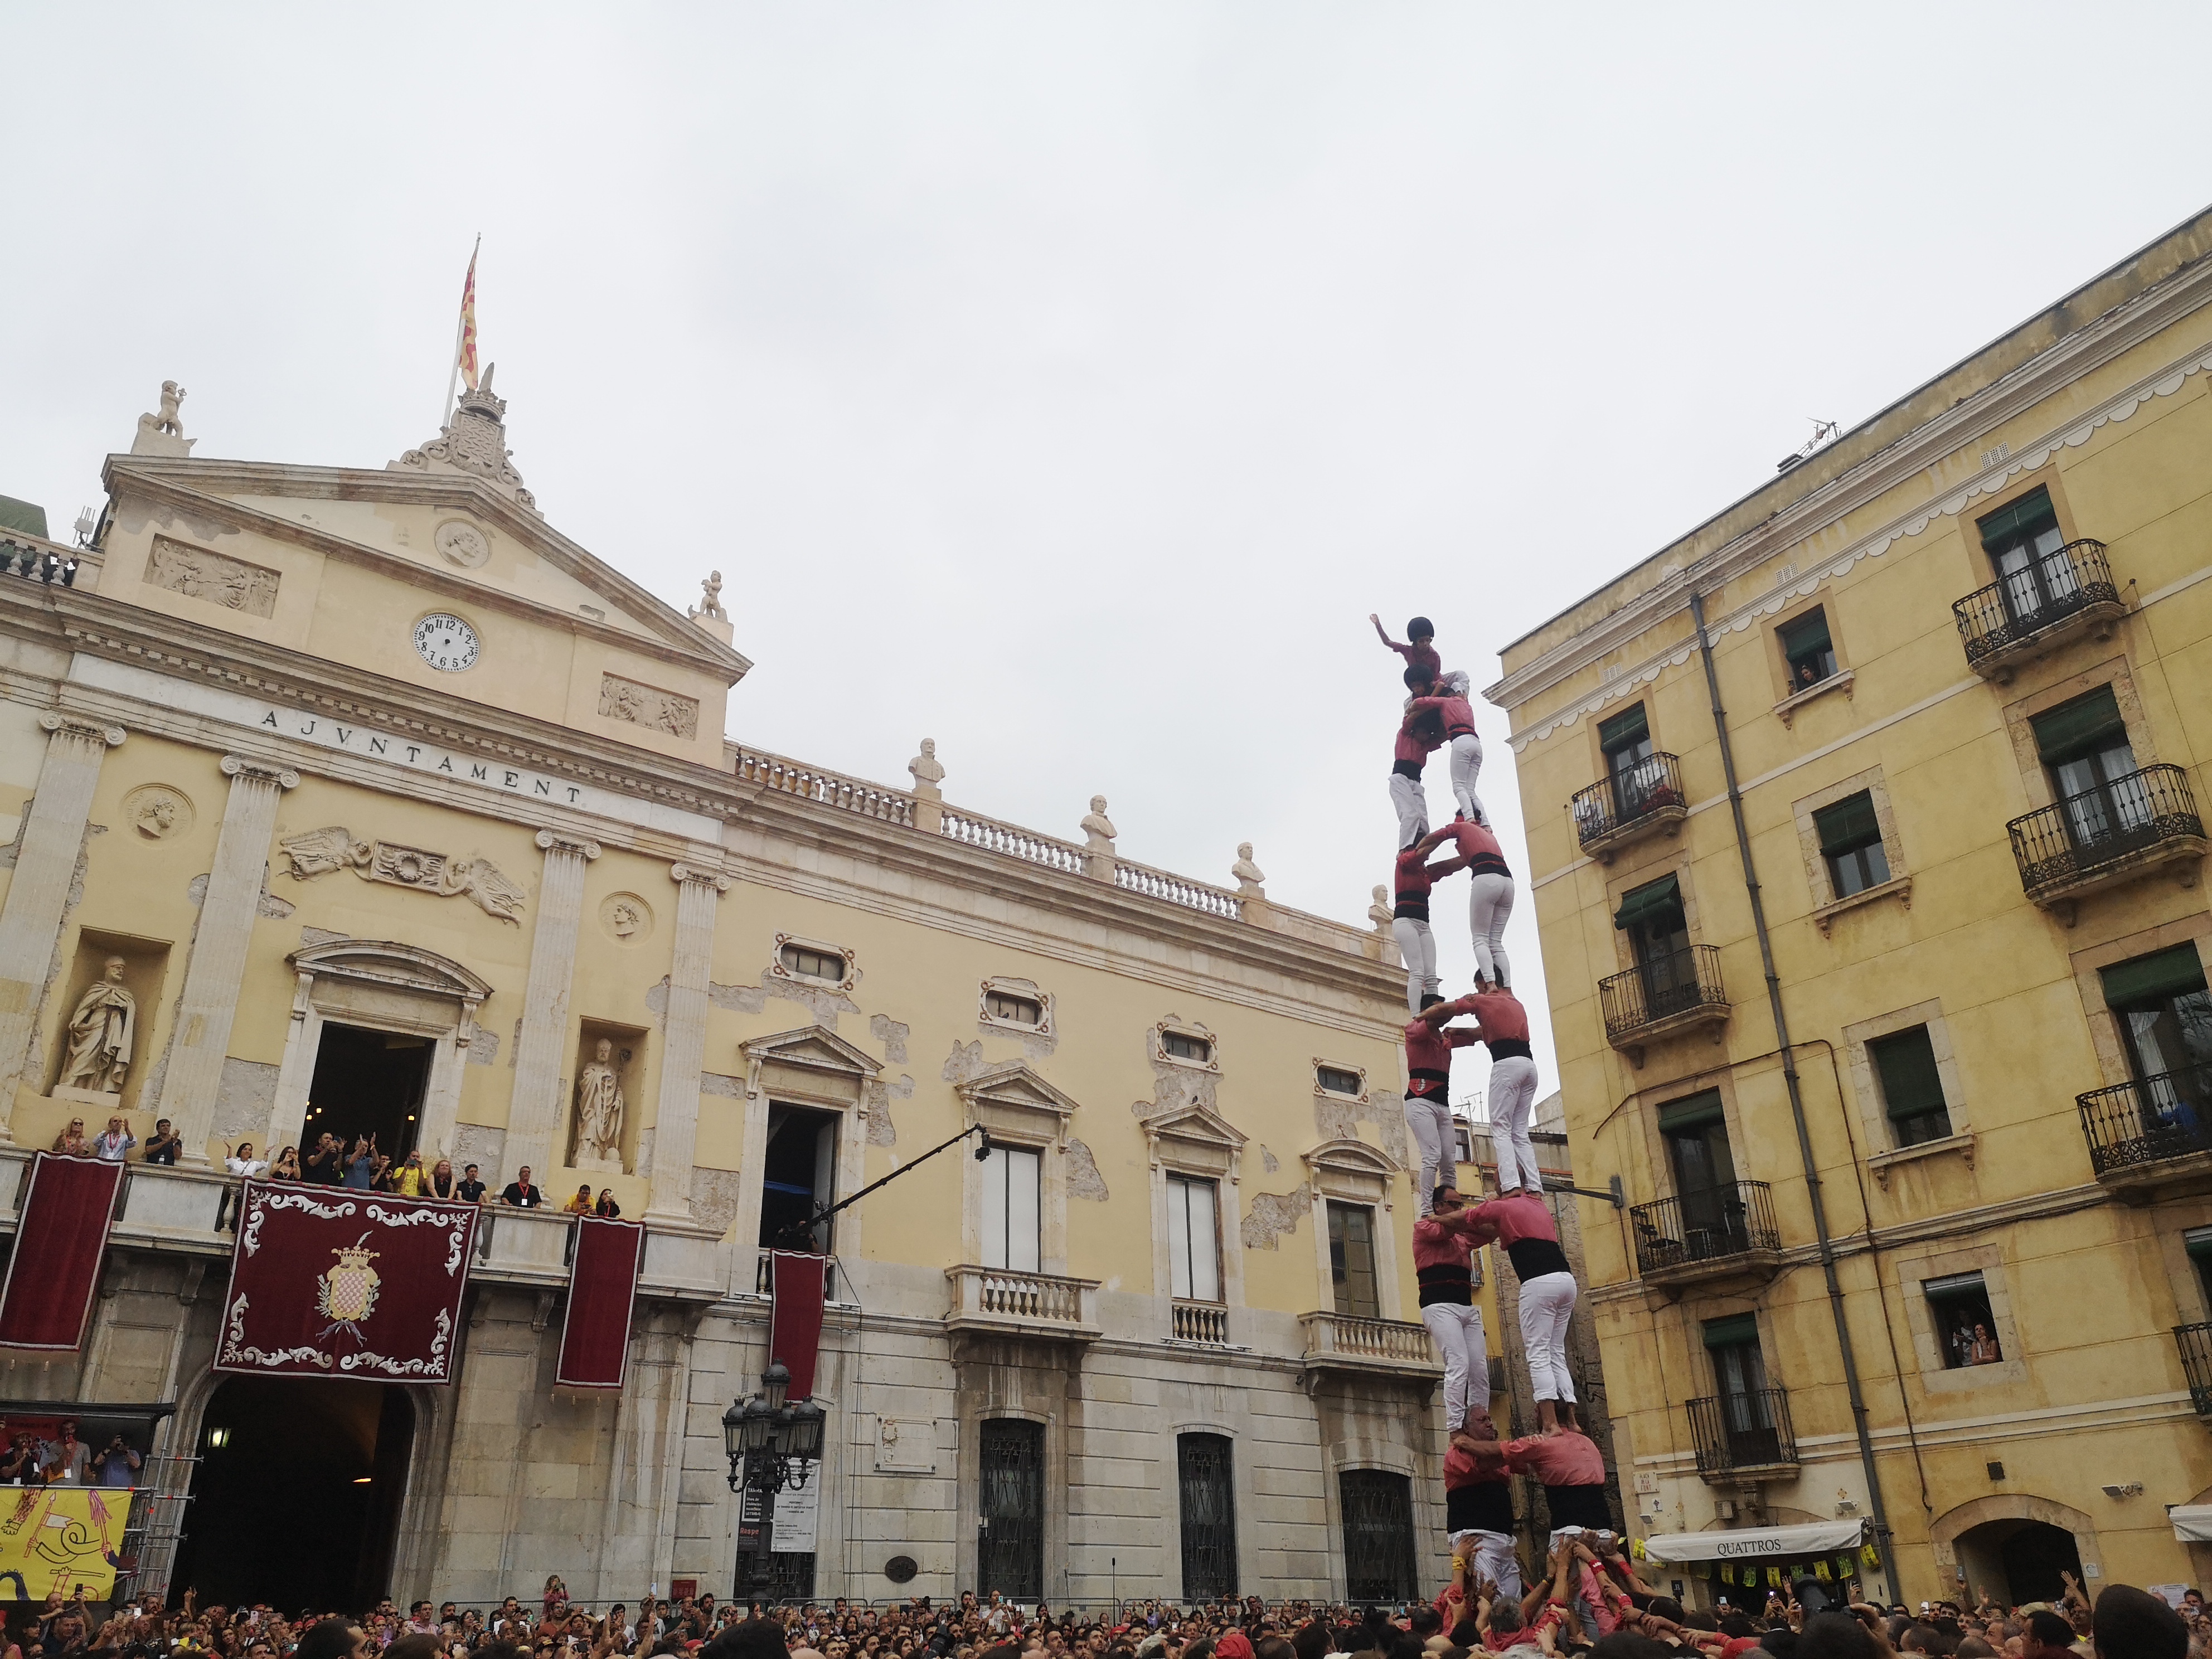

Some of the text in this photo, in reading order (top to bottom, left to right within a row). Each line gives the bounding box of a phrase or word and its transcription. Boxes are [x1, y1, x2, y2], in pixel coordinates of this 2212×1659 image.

[424, 623, 434, 633] 10
[435, 619, 443, 629] 11
[445, 620, 455, 630] 12
[418, 631, 425, 641] 9
[459, 627, 463, 636] 1
[465, 634, 472, 644] 2
[421, 642, 427, 651] 8
[468, 646, 474, 656] 3
[430, 651, 435, 660] 7
[462, 655, 468, 664] 4
[440, 657, 447, 666] 6
[452, 658, 458, 667] 5
[261, 710, 580, 803] AJVNTAMENT
[1718, 1539, 1781, 1556] QUATTROS
